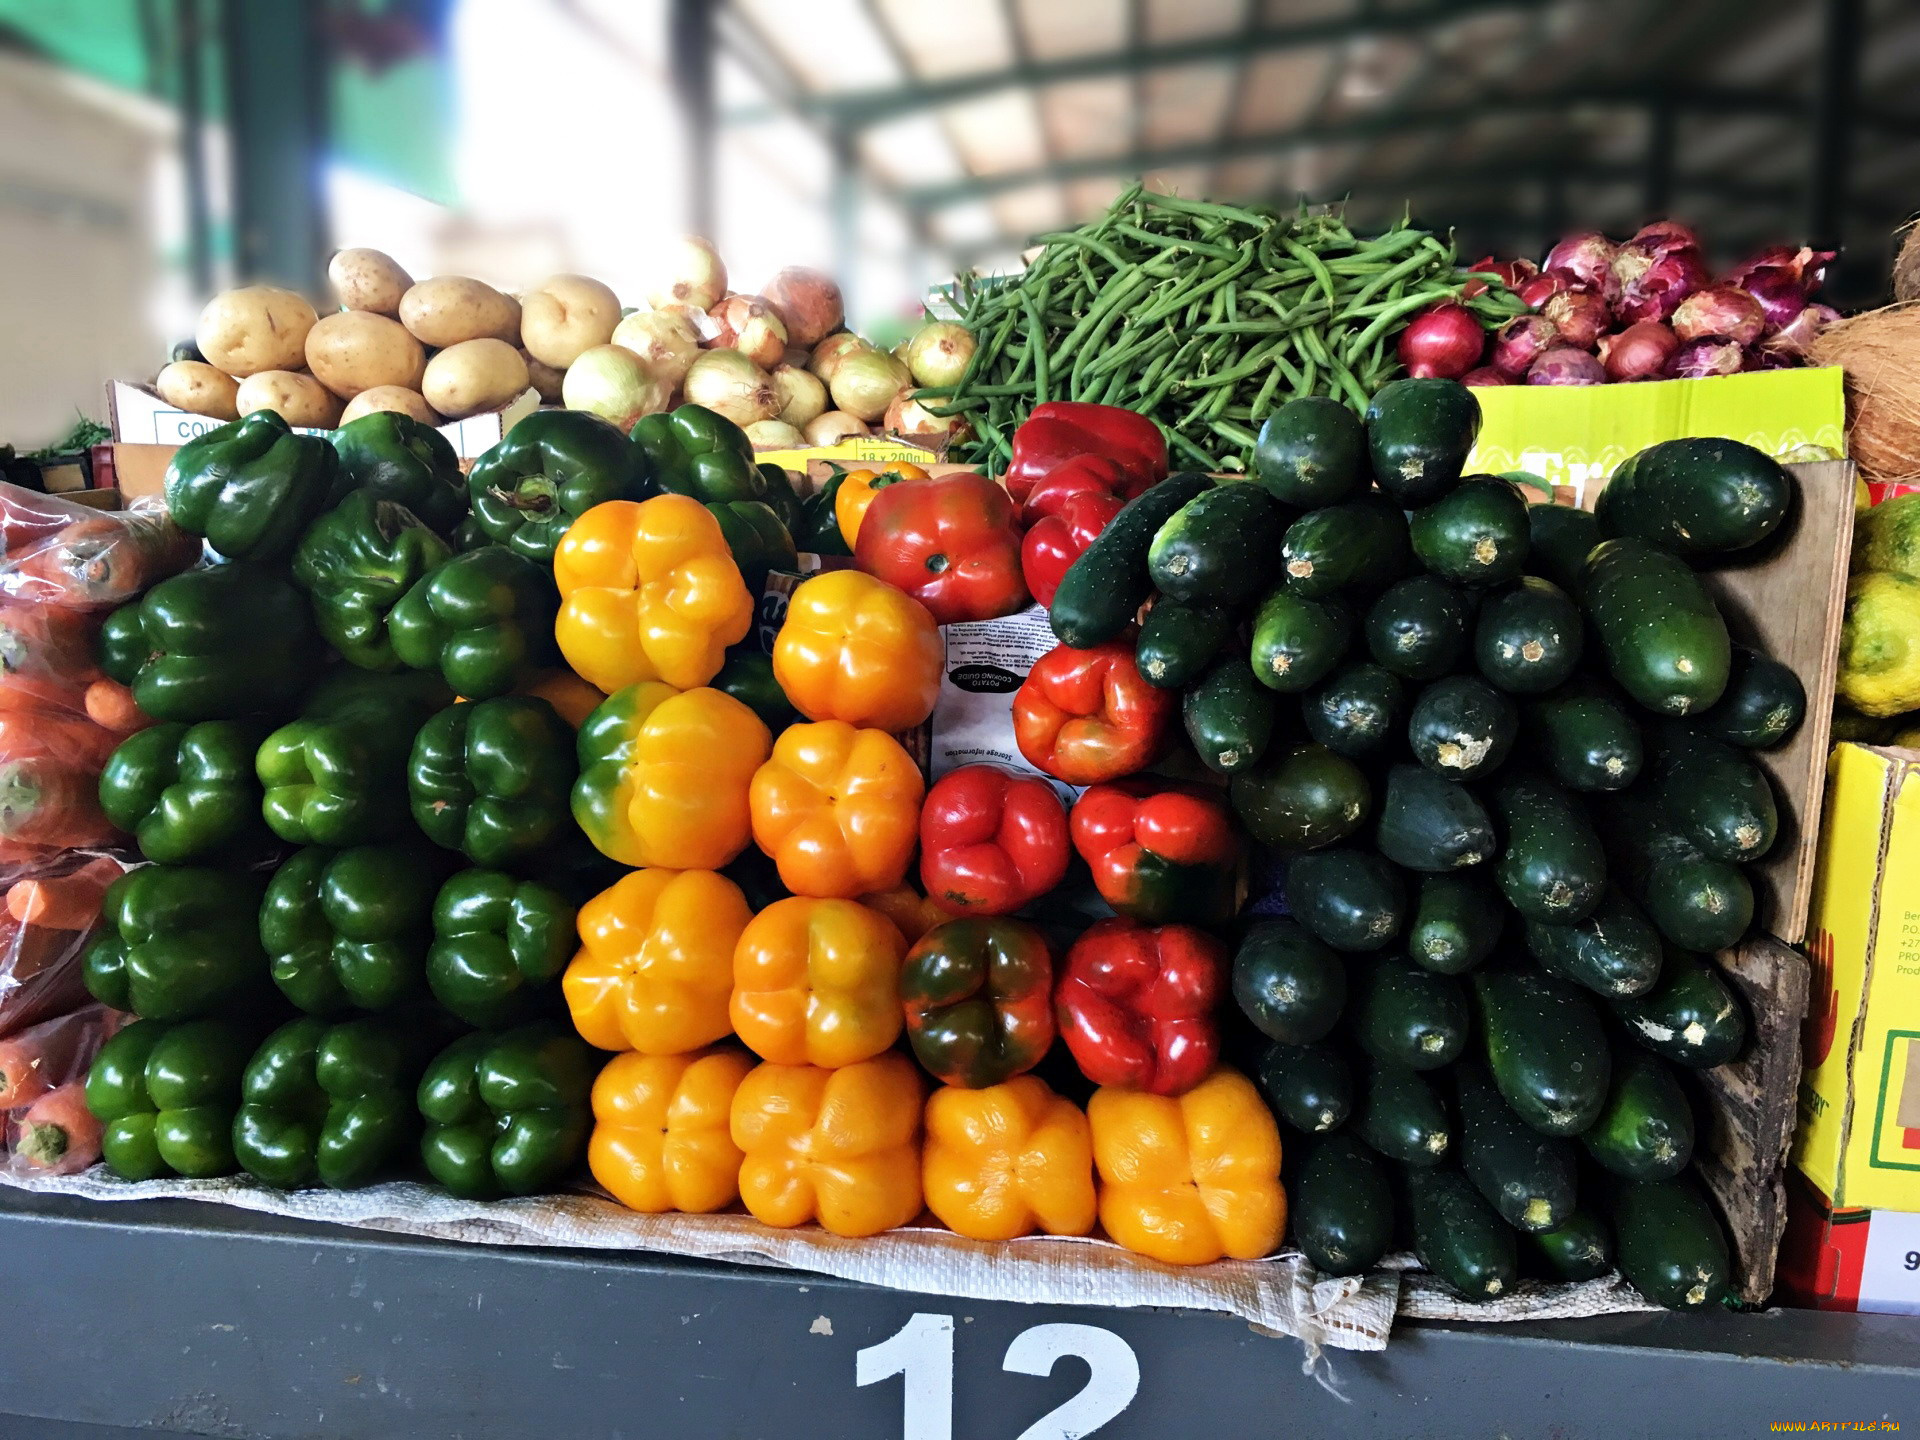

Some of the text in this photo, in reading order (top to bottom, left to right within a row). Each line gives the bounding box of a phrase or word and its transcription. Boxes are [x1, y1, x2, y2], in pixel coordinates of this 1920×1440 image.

[982, 672, 1012, 683] COOKING
[945, 748, 1013, 762] Storage information
[856, 1312, 1140, 1440] 12
